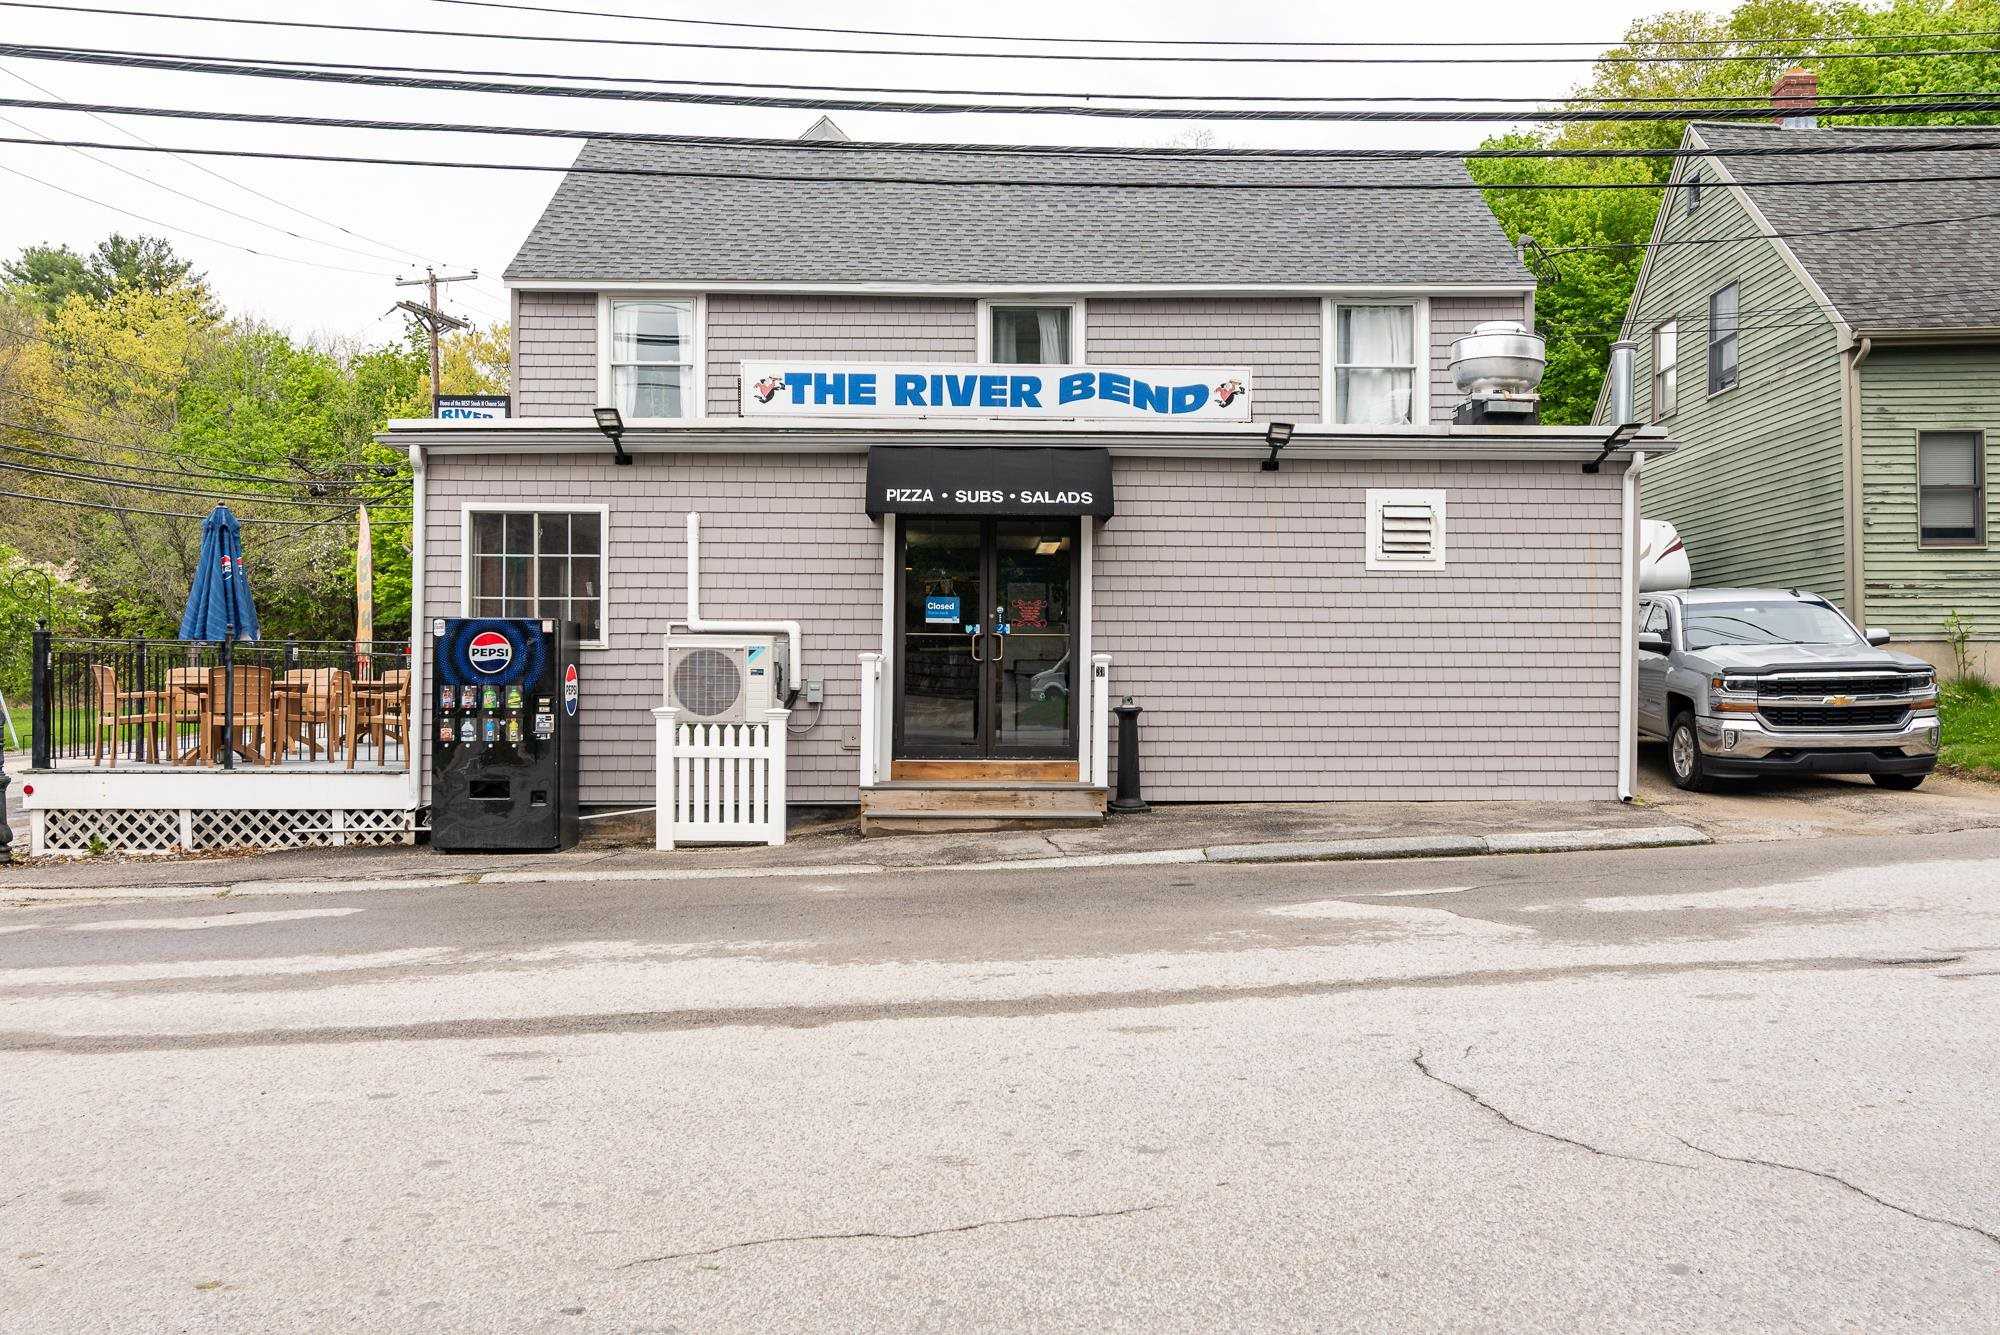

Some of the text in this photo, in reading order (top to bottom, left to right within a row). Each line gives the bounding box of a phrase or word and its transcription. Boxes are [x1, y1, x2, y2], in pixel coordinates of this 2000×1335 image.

[785, 372, 1209, 414] THE RIVER BEND
[886, 488, 1093, 504] PIZZA SUBS SALADS
[927, 602, 954, 610] Closed
[472, 648, 509, 657] PEPSI
